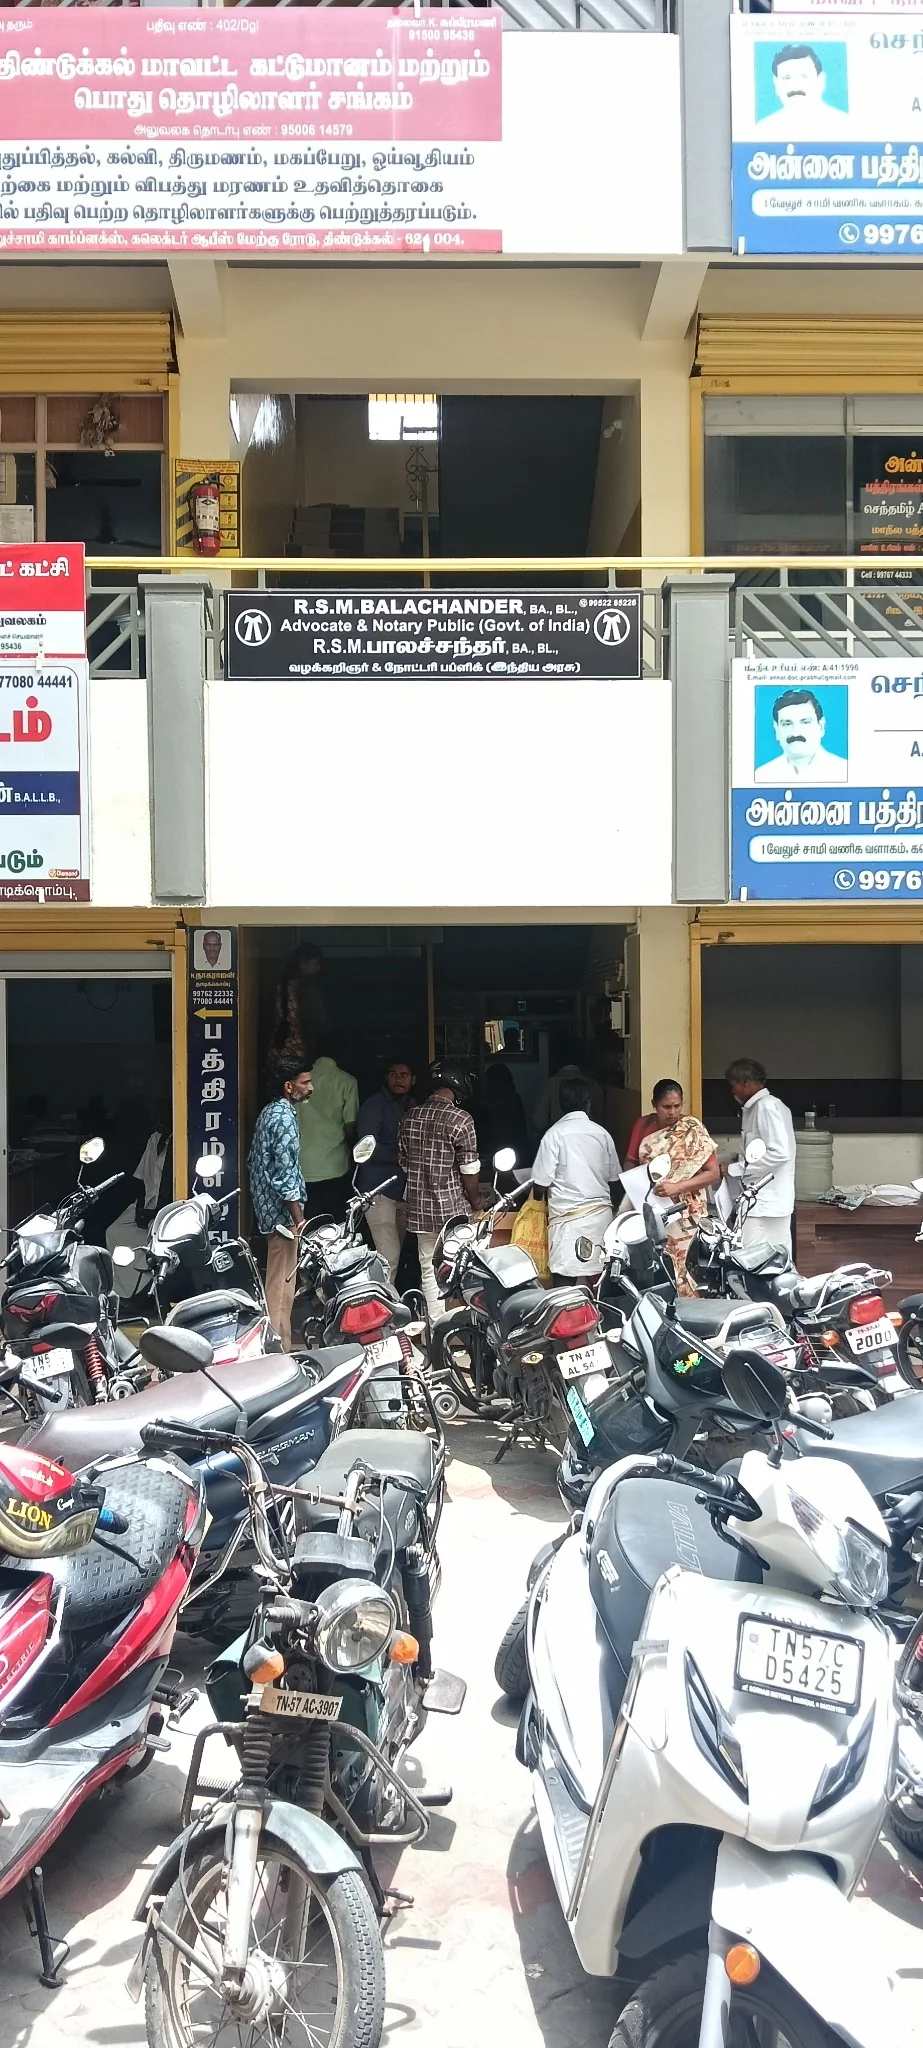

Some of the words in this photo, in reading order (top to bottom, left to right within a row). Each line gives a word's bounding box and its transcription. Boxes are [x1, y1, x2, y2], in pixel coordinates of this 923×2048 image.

[147, 19, 175, 35] பதிவு
[178, 18, 206, 32] எண்
[216, 18, 259, 34] 402/Dgl
[408, 29, 440, 40] 91500
[443, 29, 475, 40] 95436
[0, 46, 136, 80] திண்டுக்கல்
[141, 55, 238, 76] மாவட்ட
[250, 48, 393, 80] கட்டுமானம்
[398, 48, 490, 85] மற்றும்
[74, 87, 153, 117] பொது
[158, 81, 323, 117] தொழிலாளர்
[328, 81, 414, 110] சங்கம்
[133, 124, 190, 136] அலுவலக
[193, 122, 239, 139] தொடர்பு
[243, 122, 271, 136] எண்
[281, 124, 315, 135] 95006
[319, 124, 353, 135] 14579
[0, 144, 101, 170] துப்பித்தல்,
[107, 144, 163, 168] கல்வி,
[168, 146, 268, 169] திருமணம்,
[273, 146, 367, 171] மகப்பேறு,
[372, 146, 475, 172] ஓய்வூதியம்
[747, 143, 856, 181] அன்னை
[861, 142, 923, 188] பத்தி
[56, 174, 130, 197] மற்றும்
[135, 175, 207, 198] விபத்து
[212, 175, 288, 197] மரணம்
[293, 175, 444, 197] உதவித்தொகை
[24, 202, 69, 224] பதிவு
[74, 200, 128, 224] பெற்ற
[133, 201, 315, 225] தொழிலாளர்களுக்கு
[320, 201, 477, 225] பெற்றுத்தரப்படும்.
[130, 230, 187, 246] கலெக்டர்
[190, 230, 233, 247] ஆபீஸ்
[236, 231, 278, 247] மேற்கு
[282, 231, 320, 247] ரோடு,
[323, 231, 393, 247] திண்டுக்கல்
[864, 500, 915, 518] செந்தமிழ்
[872, 524, 903, 536] மாநில
[19, 556, 70, 577] கட்சி
[294, 599, 526, 615] R.S.M.BALACHANDER,
[530, 605, 552, 615] BA.,
[556, 605, 578, 615] BL.,
[280, 618, 352, 632] Advocate
[357, 619, 368, 632] &
[373, 619, 422, 635] Notary
[428, 618, 474, 632] Public
[479, 618, 524, 634] (Govt.
[529, 618, 545, 632] of
[549, 618, 591, 634] India)
[314, 637, 509, 658] R.S.M.பாலச்சந்தர்,
[512, 643, 534, 654] BA.,
[538, 643, 559, 654] BL.,
[289, 662, 369, 675] வழக்கறிஞர்
[372, 662, 382, 672] &
[385, 661, 438, 674] நோட்டரி
[441, 661, 483, 672] பப்ளிக்
[486, 661, 540, 674] (இந்திய
[542, 662, 581, 673] அரசு)
[37, 675, 72, 688] 44441
[745, 789, 853, 827] அன்னை
[858, 788, 923, 834] பத்தி
[767, 843, 801, 859] வேலுச்
[803, 843, 827, 854] சாமி
[829, 843, 863, 854] வணிக
[858, 870, 923, 891] 9976
[856, 1331, 892, 1350] 2000
[569, 1353, 583, 1363] TN
[6, 1497, 53, 1530] LION
[771, 1627, 845, 1668] TN57C
[766, 1654, 841, 1695] D5425
[276, 1695, 302, 1712] TN-57
[302, 1697, 339, 1716] AC-3907
